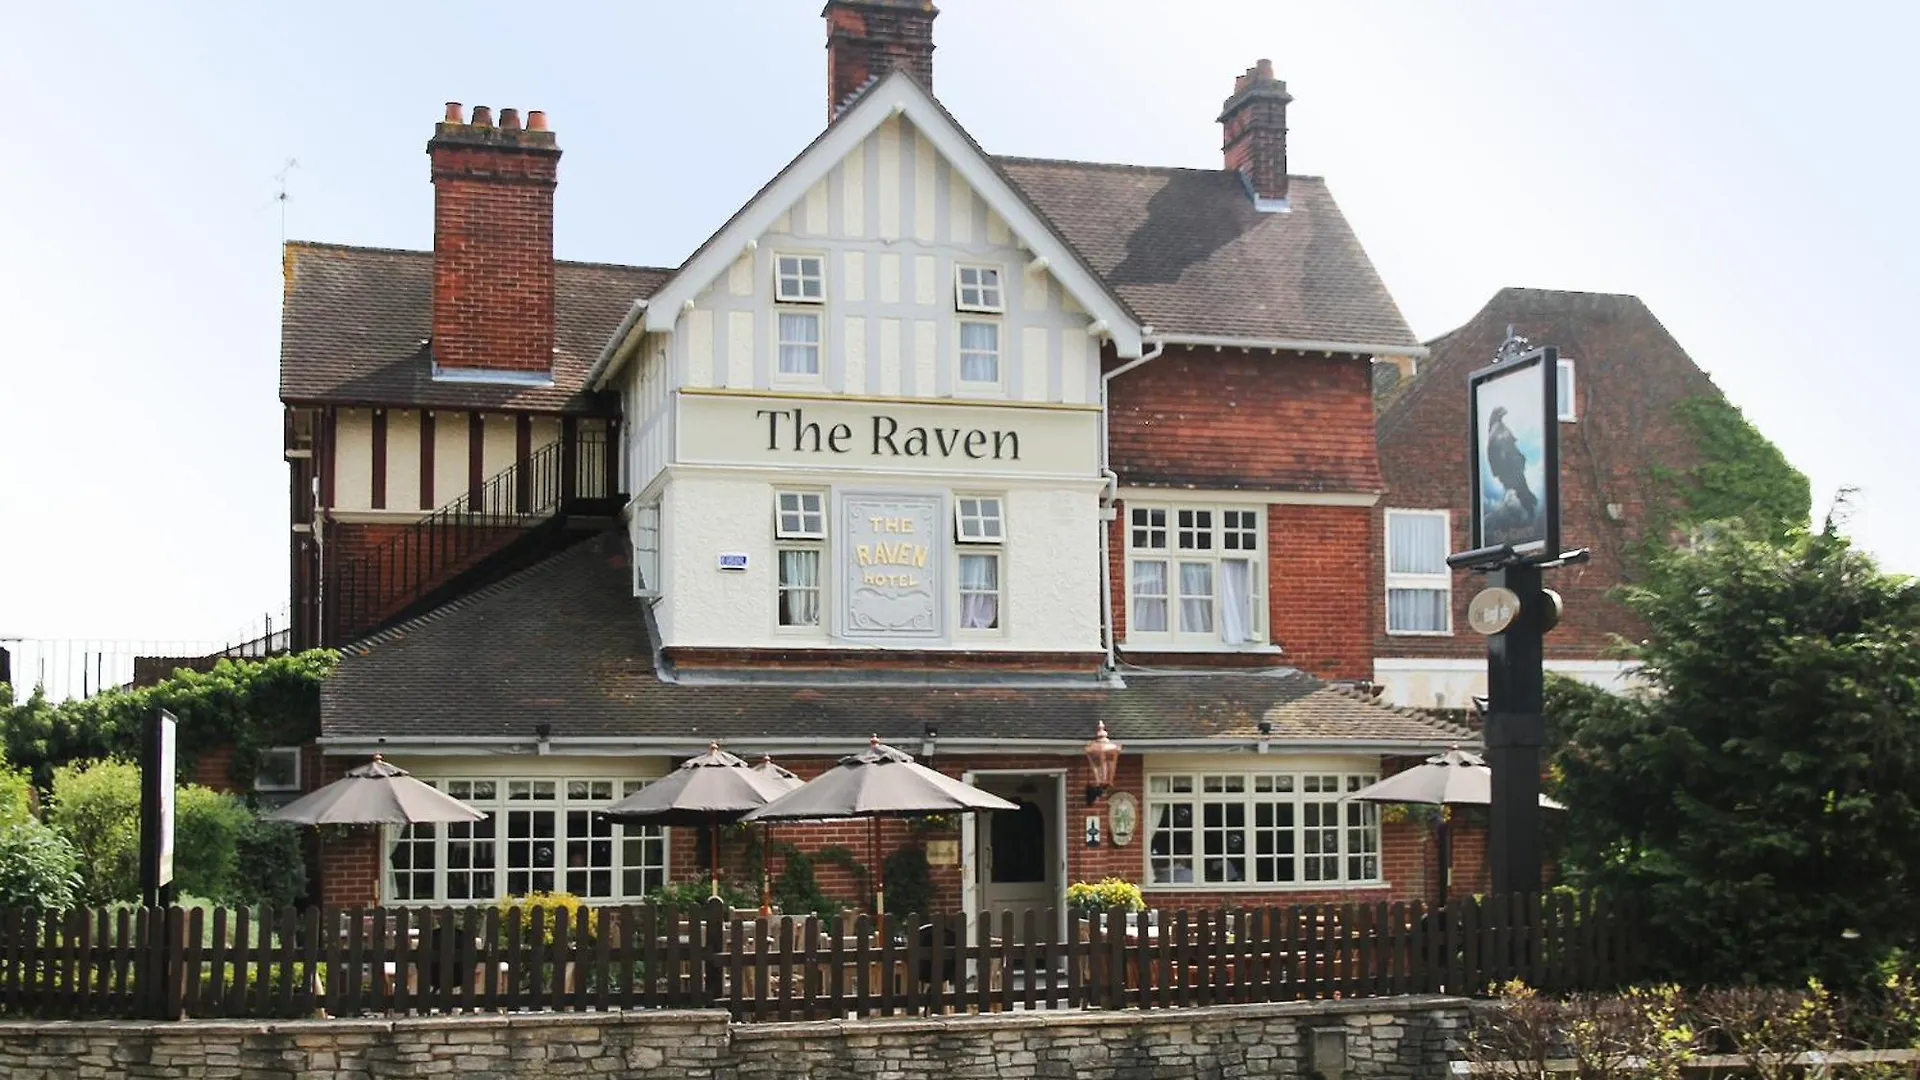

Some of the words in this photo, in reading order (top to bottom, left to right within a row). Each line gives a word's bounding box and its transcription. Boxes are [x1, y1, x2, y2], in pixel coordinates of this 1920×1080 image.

[757, 408, 852, 454] The
[871, 415, 1021, 461] Raven
[868, 516, 915, 534] THE
[856, 541, 928, 568] RAVEN
[864, 574, 919, 588] HOTEL
